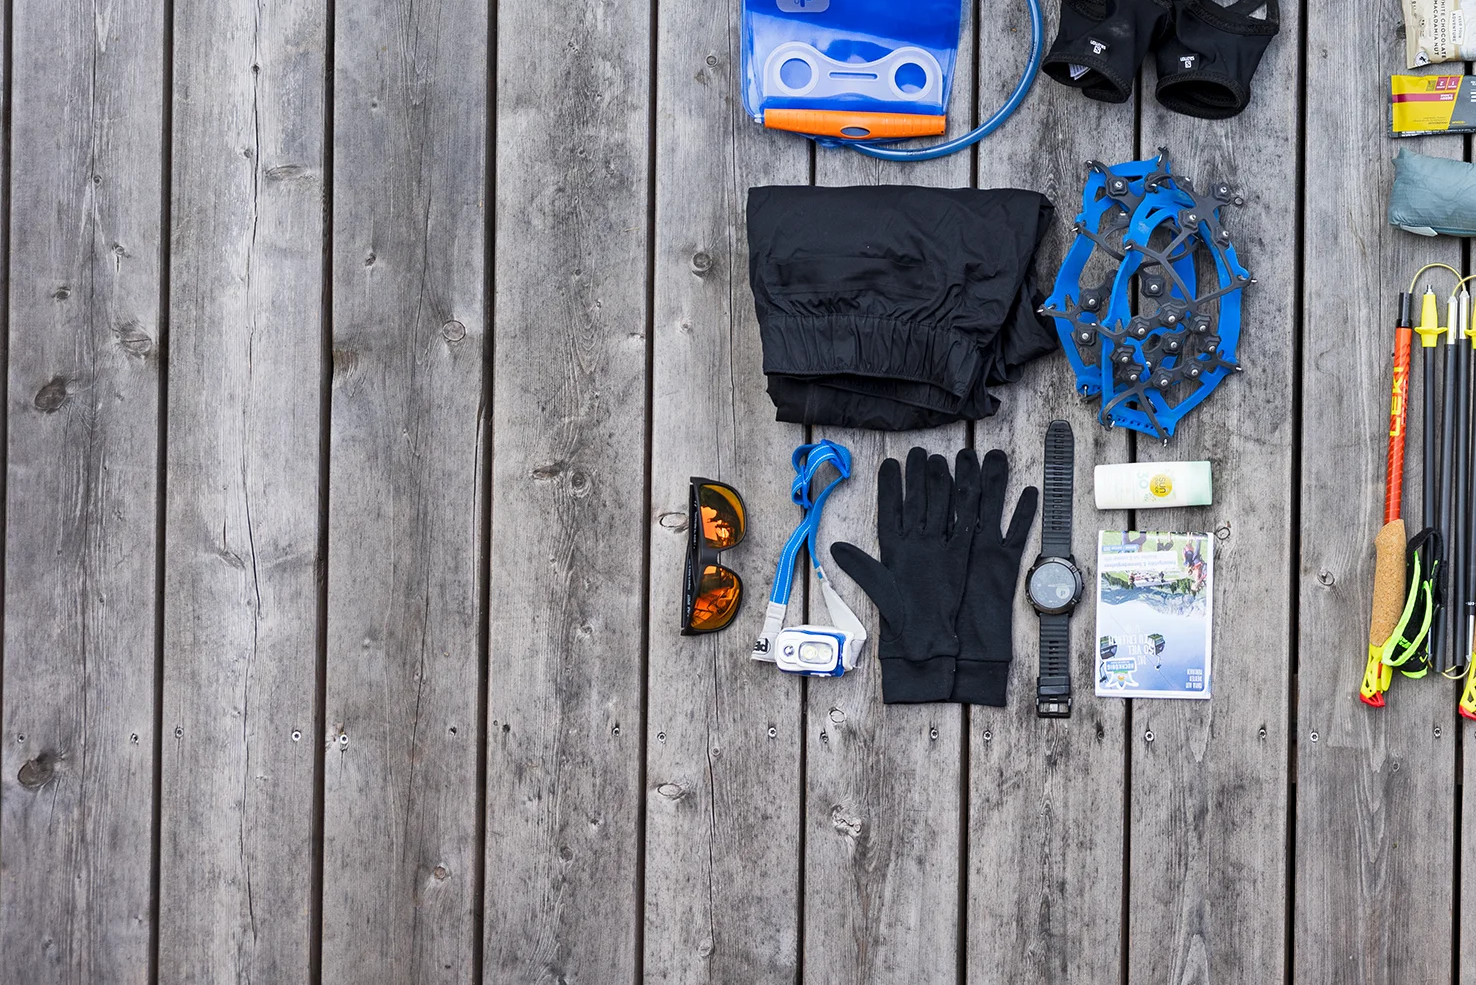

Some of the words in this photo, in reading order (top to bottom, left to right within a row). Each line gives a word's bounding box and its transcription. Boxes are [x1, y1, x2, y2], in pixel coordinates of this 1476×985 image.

[1389, 367, 1404, 436] LEKI
[1137, 471, 1149, 490] 30
[1158, 477, 1167, 494] sun
